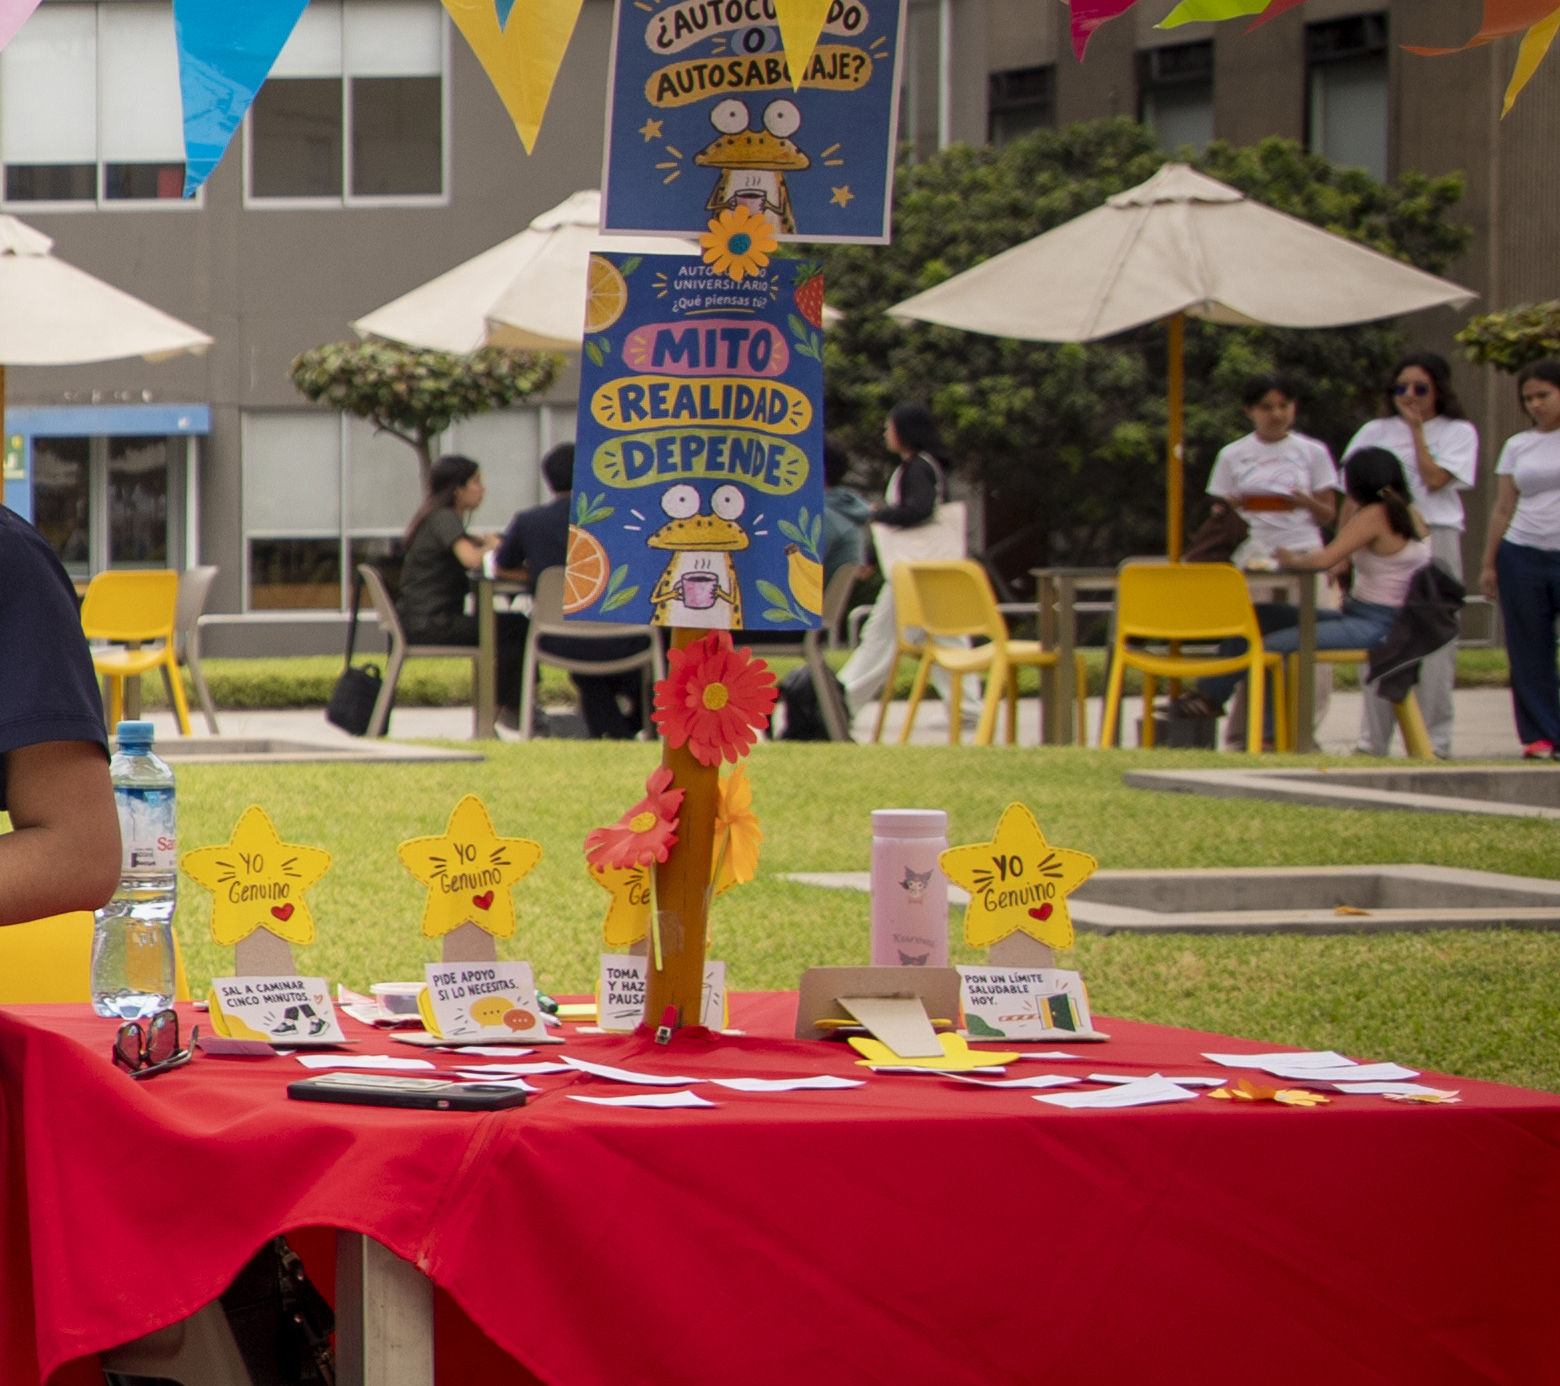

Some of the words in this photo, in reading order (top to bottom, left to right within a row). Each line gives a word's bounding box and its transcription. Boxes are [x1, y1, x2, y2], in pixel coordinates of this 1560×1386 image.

[742, 27, 766, 54] O
[673, 279, 768, 291] UNIVERSITARIO
[672, 295, 702, 313] ¿Qué
[704, 293, 750, 307] piensas
[651, 327, 773, 373] MITO
[617, 382, 790, 426] REALIDAD
[620, 434, 787, 487] DEPENDE
[238, 852, 264, 875] YO
[453, 843, 476, 865] YO
[992, 854, 1024, 881] YO
[228, 876, 290, 904] Genuino
[440, 866, 502, 894] Genuino
[984, 881, 1056, 912] Genuino
[432, 971, 456, 988] PIDE
[461, 969, 496, 983] APOYO
[606, 967, 639, 979] TOMA
[965, 974, 988, 983] PON
[990, 975, 1006, 983] UN
[1009, 972, 1044, 983] LÍMITE
[222, 986, 241, 997] SAL
[245, 985, 254, 995] A
[256, 980, 306, 993] CAMINAR
[438, 989, 450, 1001] SI
[452, 987, 466, 999] LO
[468, 979, 520, 996] NECESITAS.
[608, 981, 617, 991] Y
[622, 981, 645, 992] HAZ
[968, 984, 1030, 995] SALUDABLE
[226, 996, 260, 1008] CINCO
[263, 993, 312, 1005] MINUTOS.
[971, 997, 998, 1006] HOY.
